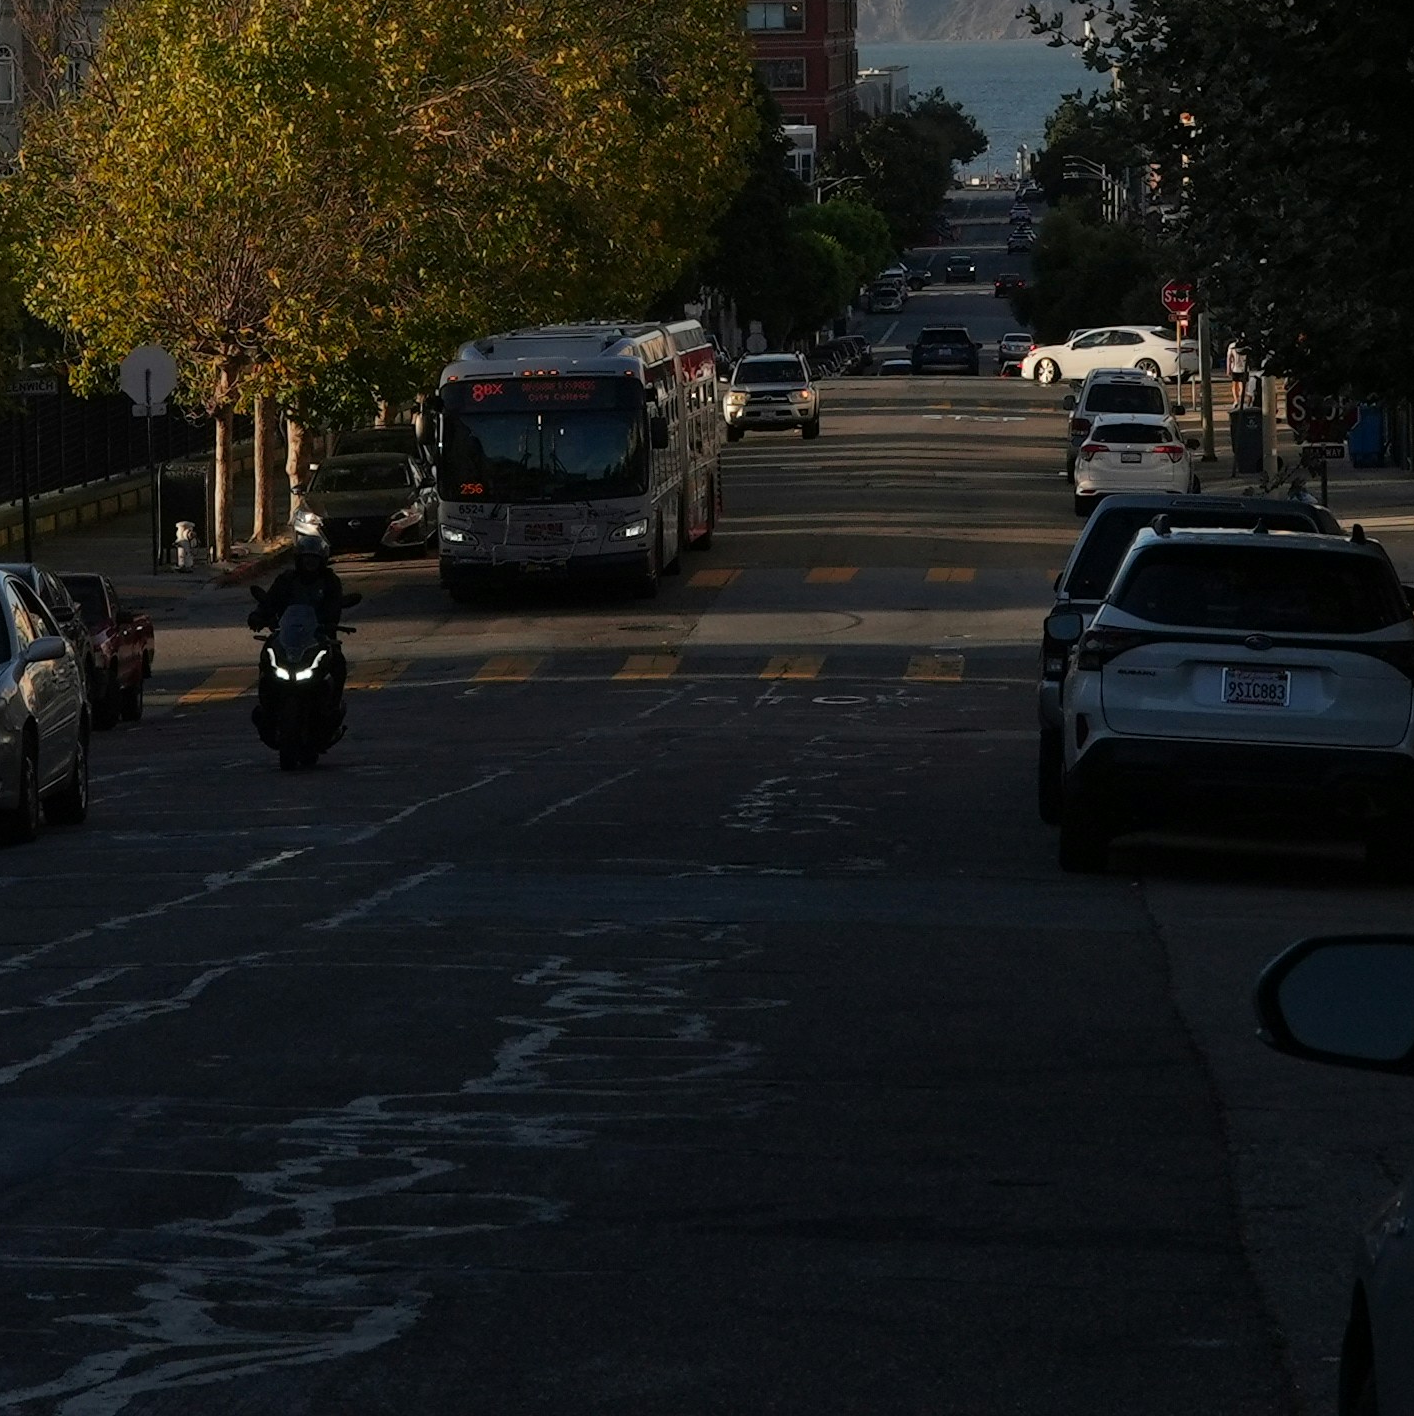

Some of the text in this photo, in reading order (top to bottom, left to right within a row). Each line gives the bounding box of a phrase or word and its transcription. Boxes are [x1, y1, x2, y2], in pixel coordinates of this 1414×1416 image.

[471, 382, 505, 402] 8BX
[1325, 448, 1342, 457] WAY
[460, 482, 484, 495] 256
[458, 504, 484, 515] 6524
[1228, 681, 1286, 700] 9SIC883
